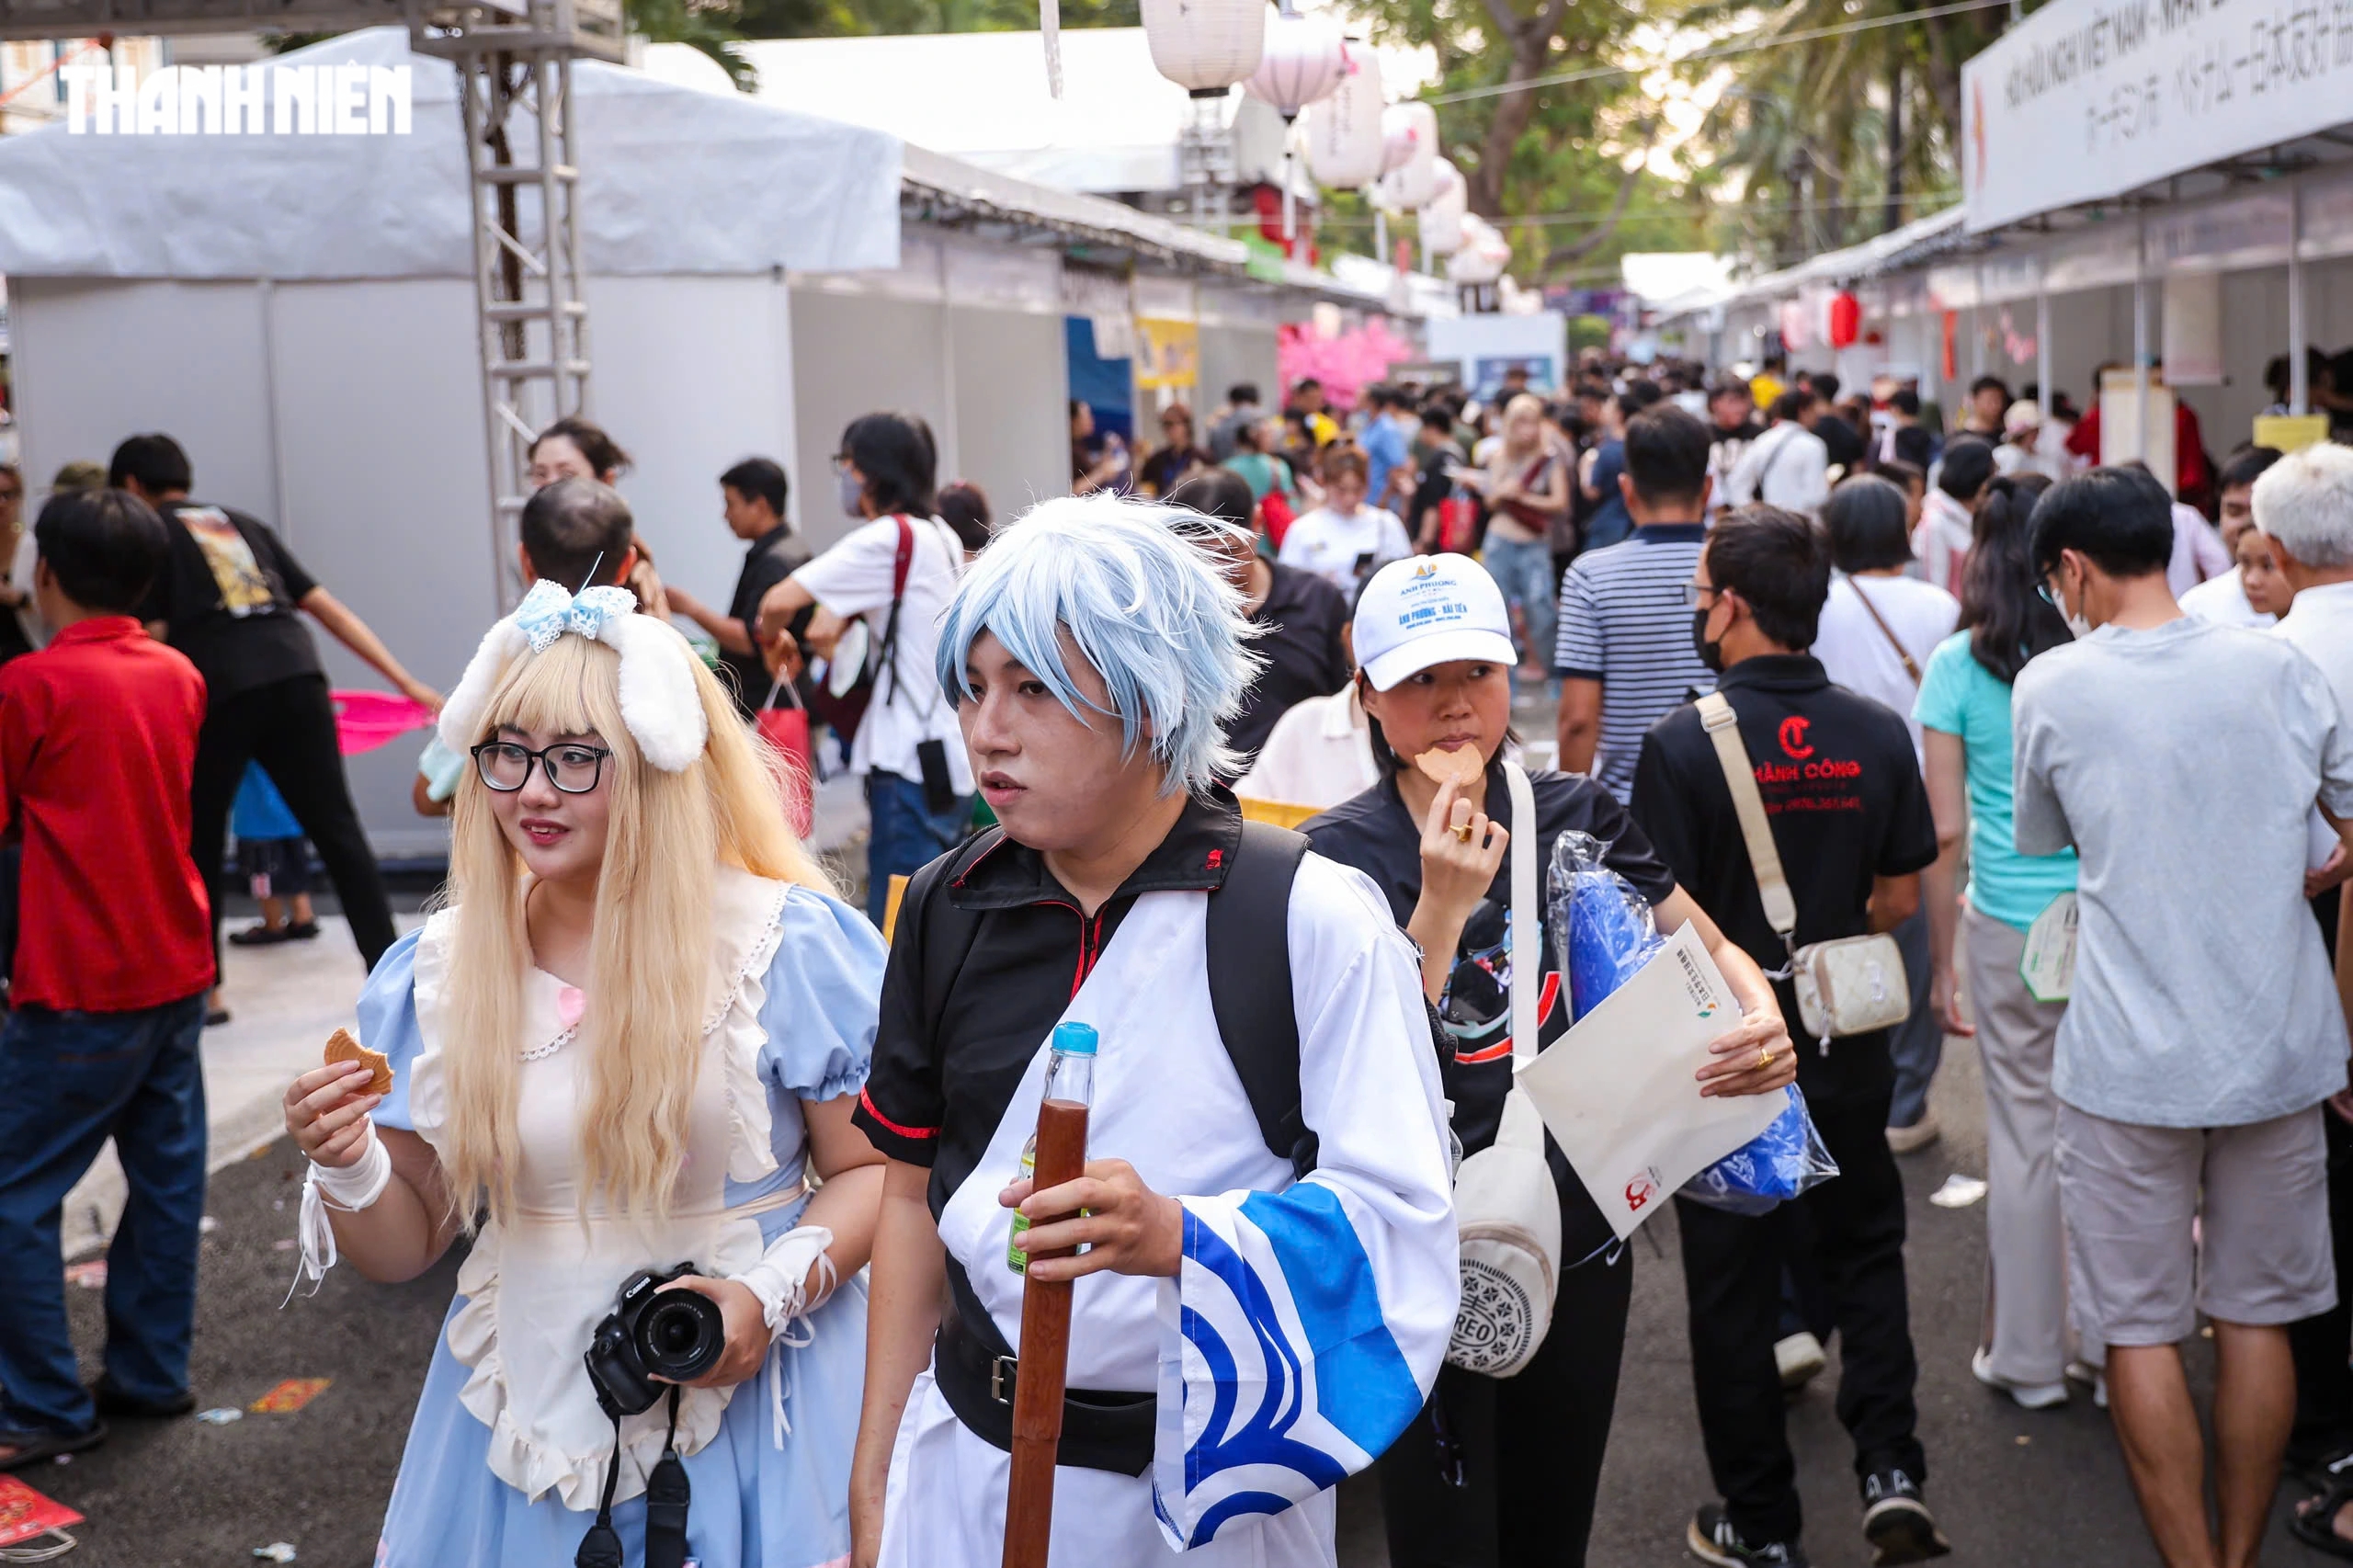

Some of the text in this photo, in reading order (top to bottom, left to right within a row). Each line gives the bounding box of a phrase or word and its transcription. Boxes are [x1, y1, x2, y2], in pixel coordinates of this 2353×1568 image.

[1755, 758, 1862, 783] HÀNH CÔNG
[626, 1277, 651, 1299] Canon
[1454, 1314, 1490, 1342] REO
